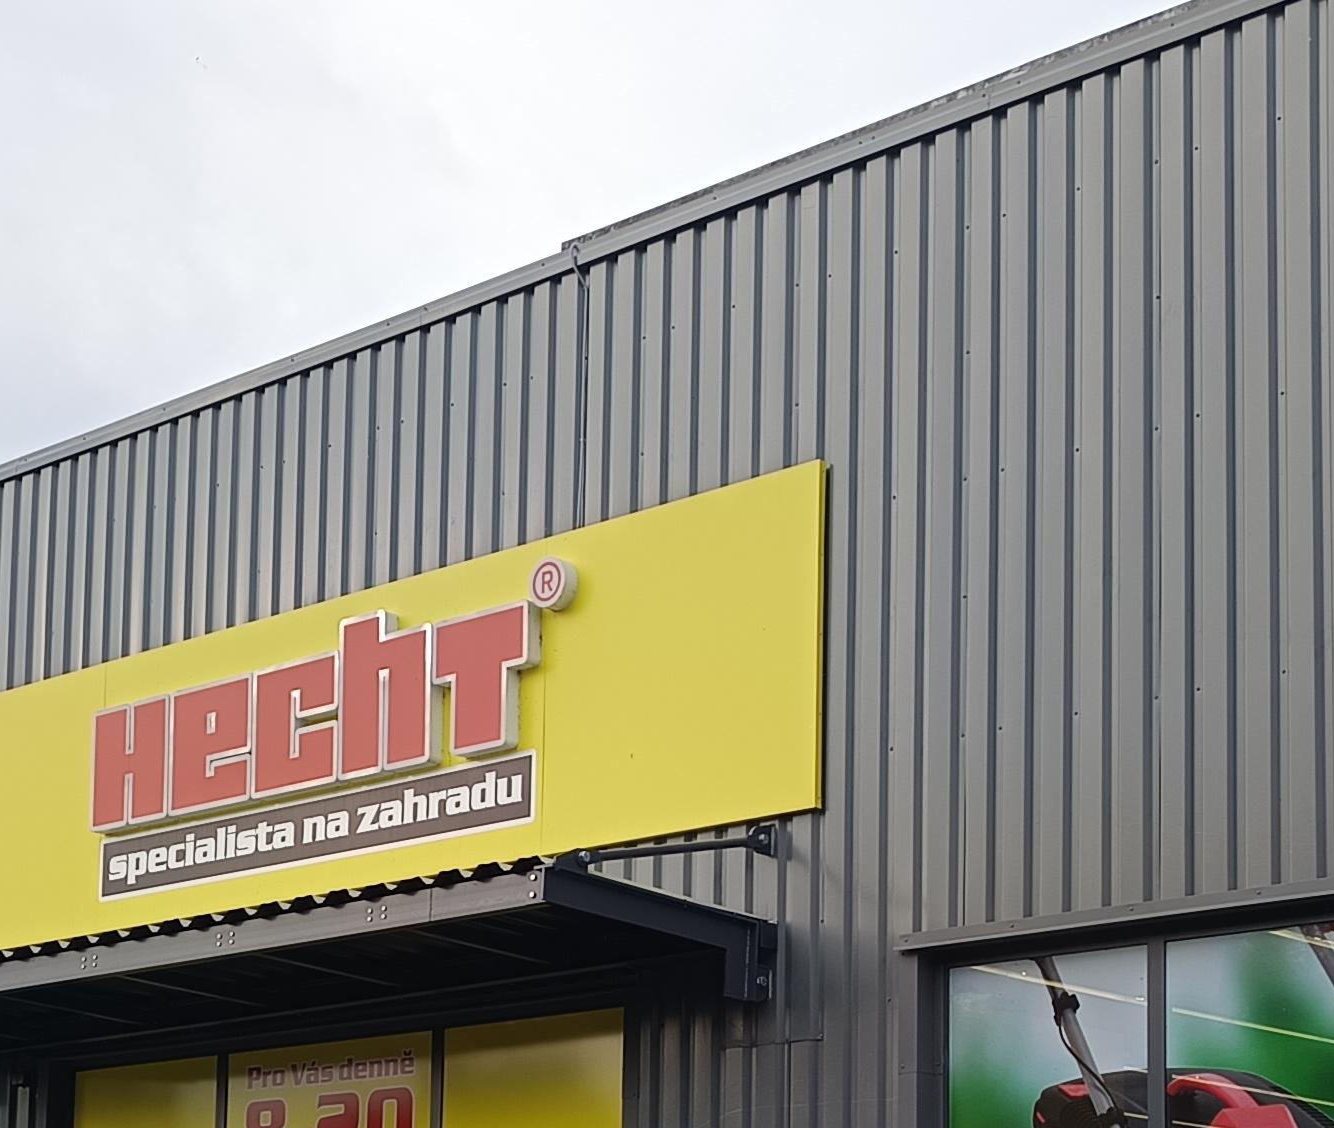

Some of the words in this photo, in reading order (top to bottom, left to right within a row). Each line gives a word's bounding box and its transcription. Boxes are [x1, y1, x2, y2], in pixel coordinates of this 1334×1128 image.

[108, 821, 295, 885] specialista
[302, 814, 351, 845] na
[356, 771, 523, 833] zahradu
[246, 1065, 286, 1089] Pro
[290, 1060, 334, 1086] Vás
[338, 1049, 415, 1081] denně
